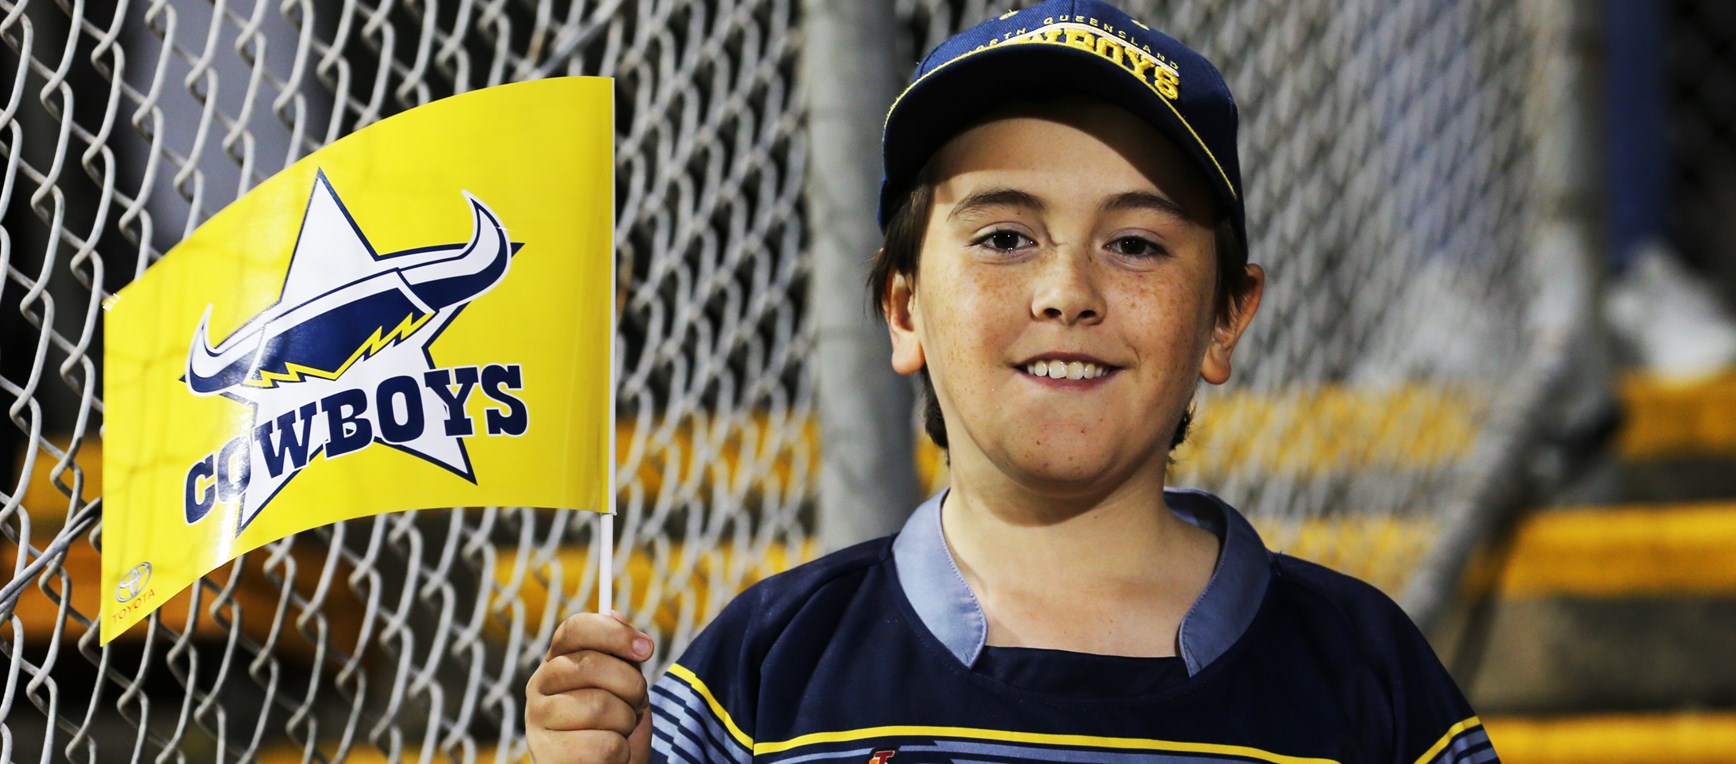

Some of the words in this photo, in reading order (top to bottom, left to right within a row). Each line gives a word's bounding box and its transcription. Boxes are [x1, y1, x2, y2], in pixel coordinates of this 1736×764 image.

[1043, 14, 1179, 70] QUEENSLAND
[184, 363, 528, 525] COWBOYS
[112, 589, 155, 623] TOYOTA
